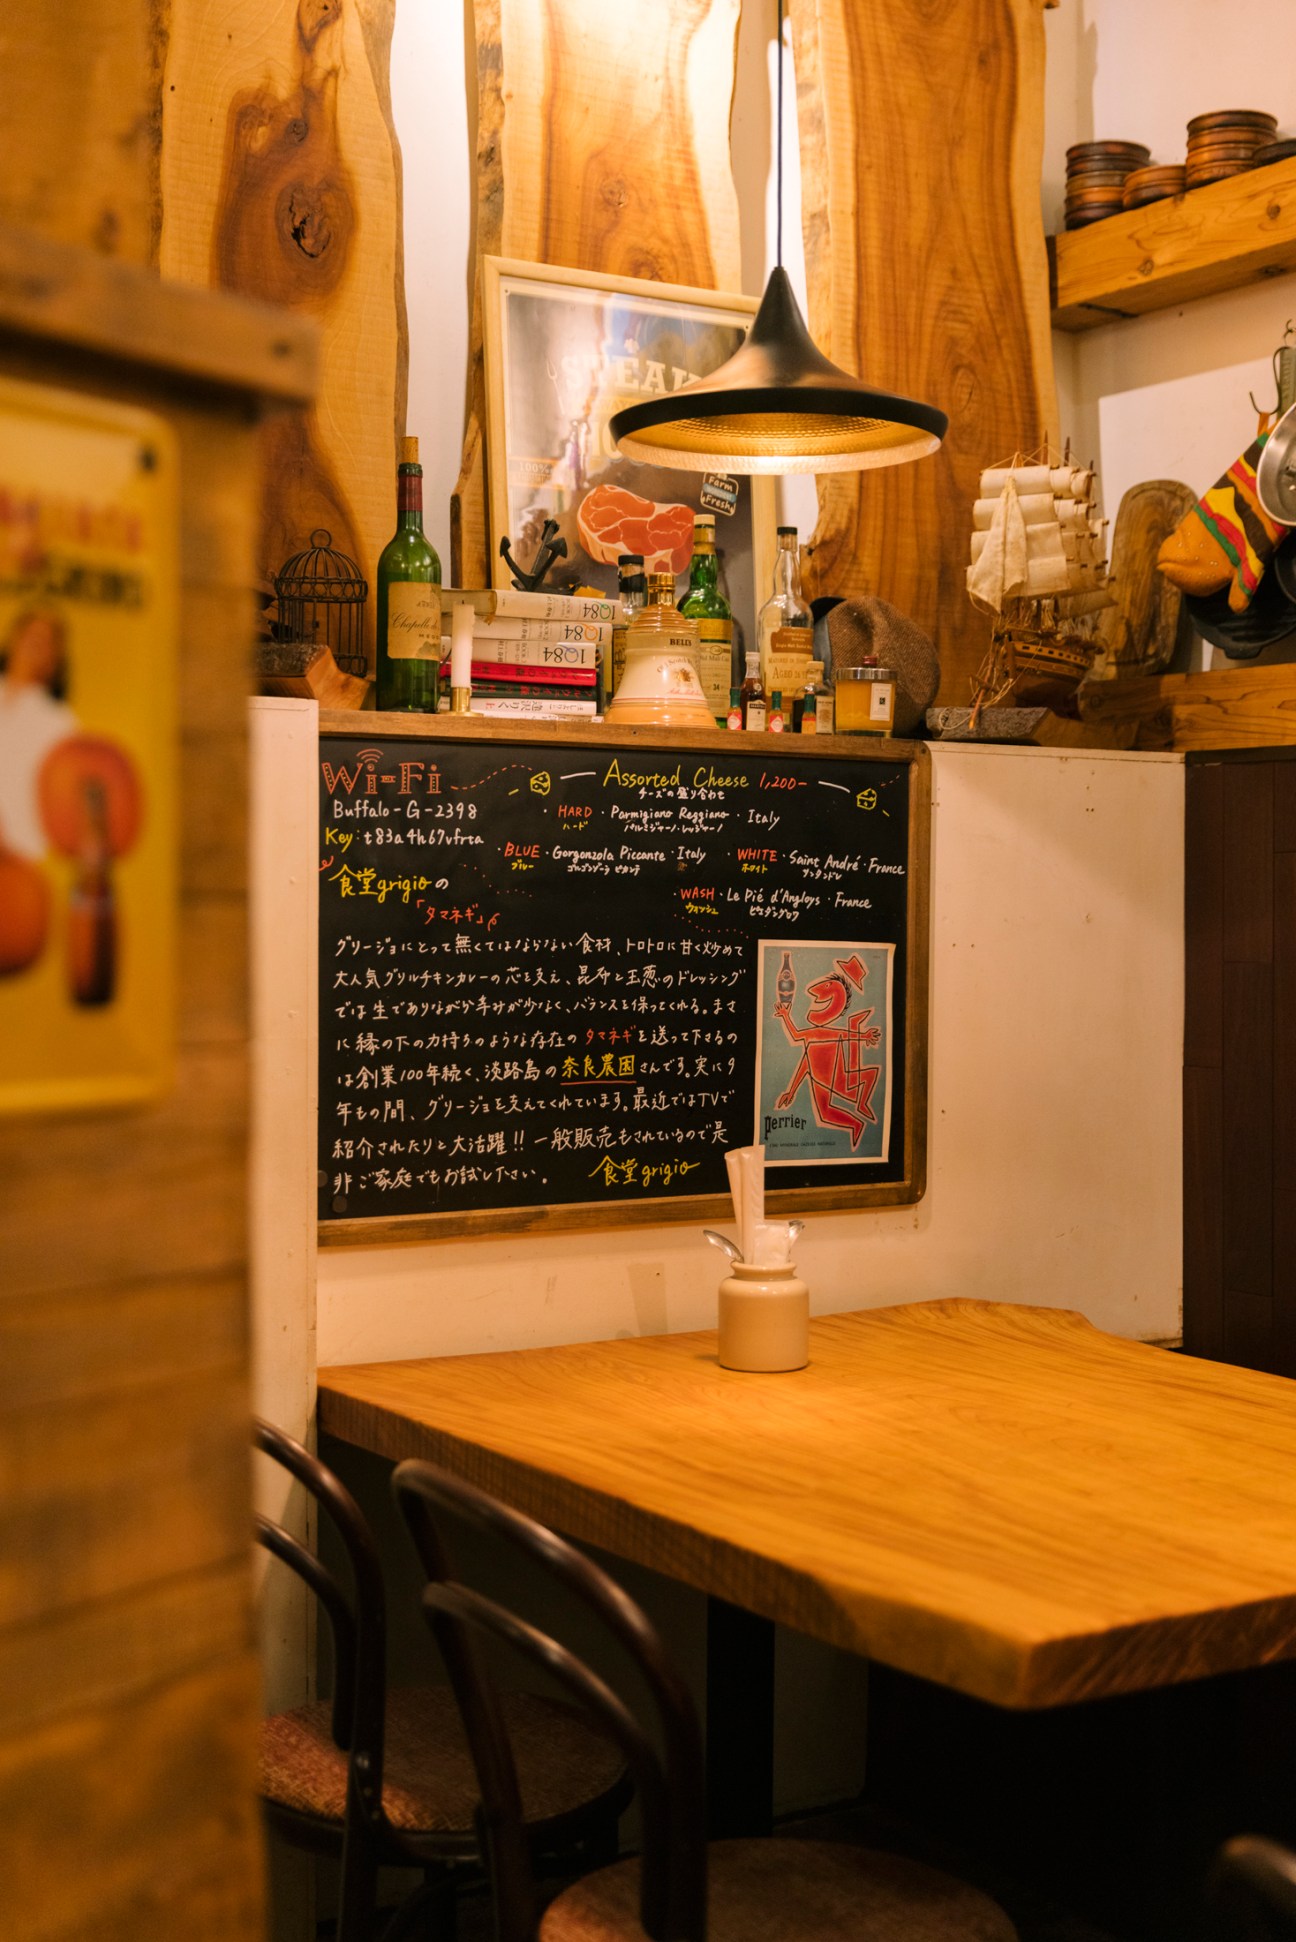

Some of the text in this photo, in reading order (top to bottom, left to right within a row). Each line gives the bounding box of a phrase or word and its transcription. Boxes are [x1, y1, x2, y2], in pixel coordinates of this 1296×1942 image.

[709, 475, 733, 492] Farm
[705, 494, 730, 510] Fresh
[583, 600, 616, 620] 1Q84
[564, 623, 604, 642] 1Q84
[543, 643, 585, 664] 1Q84
[318, 761, 441, 797] Wi-Fi
[603, 759, 681, 789] Assorted
[694, 767, 748, 789] Cheese
[639, 787, 724, 800] チーズの盛り合わせ
[334, 799, 477, 819] Buffalo-G-2398
[558, 805, 780, 830] HARD Parmigiano Reggiano Italy
[504, 842, 706, 867] BLUE Gorgonzola Piccante Italy
[512, 859, 534, 870] ブルー
[738, 848, 905, 874] WHITE Saint André France
[742, 863, 767, 873] ホワイト
[681, 887, 714, 900] WASH
[727, 888, 740, 901] Le
[835, 892, 871, 908] France
